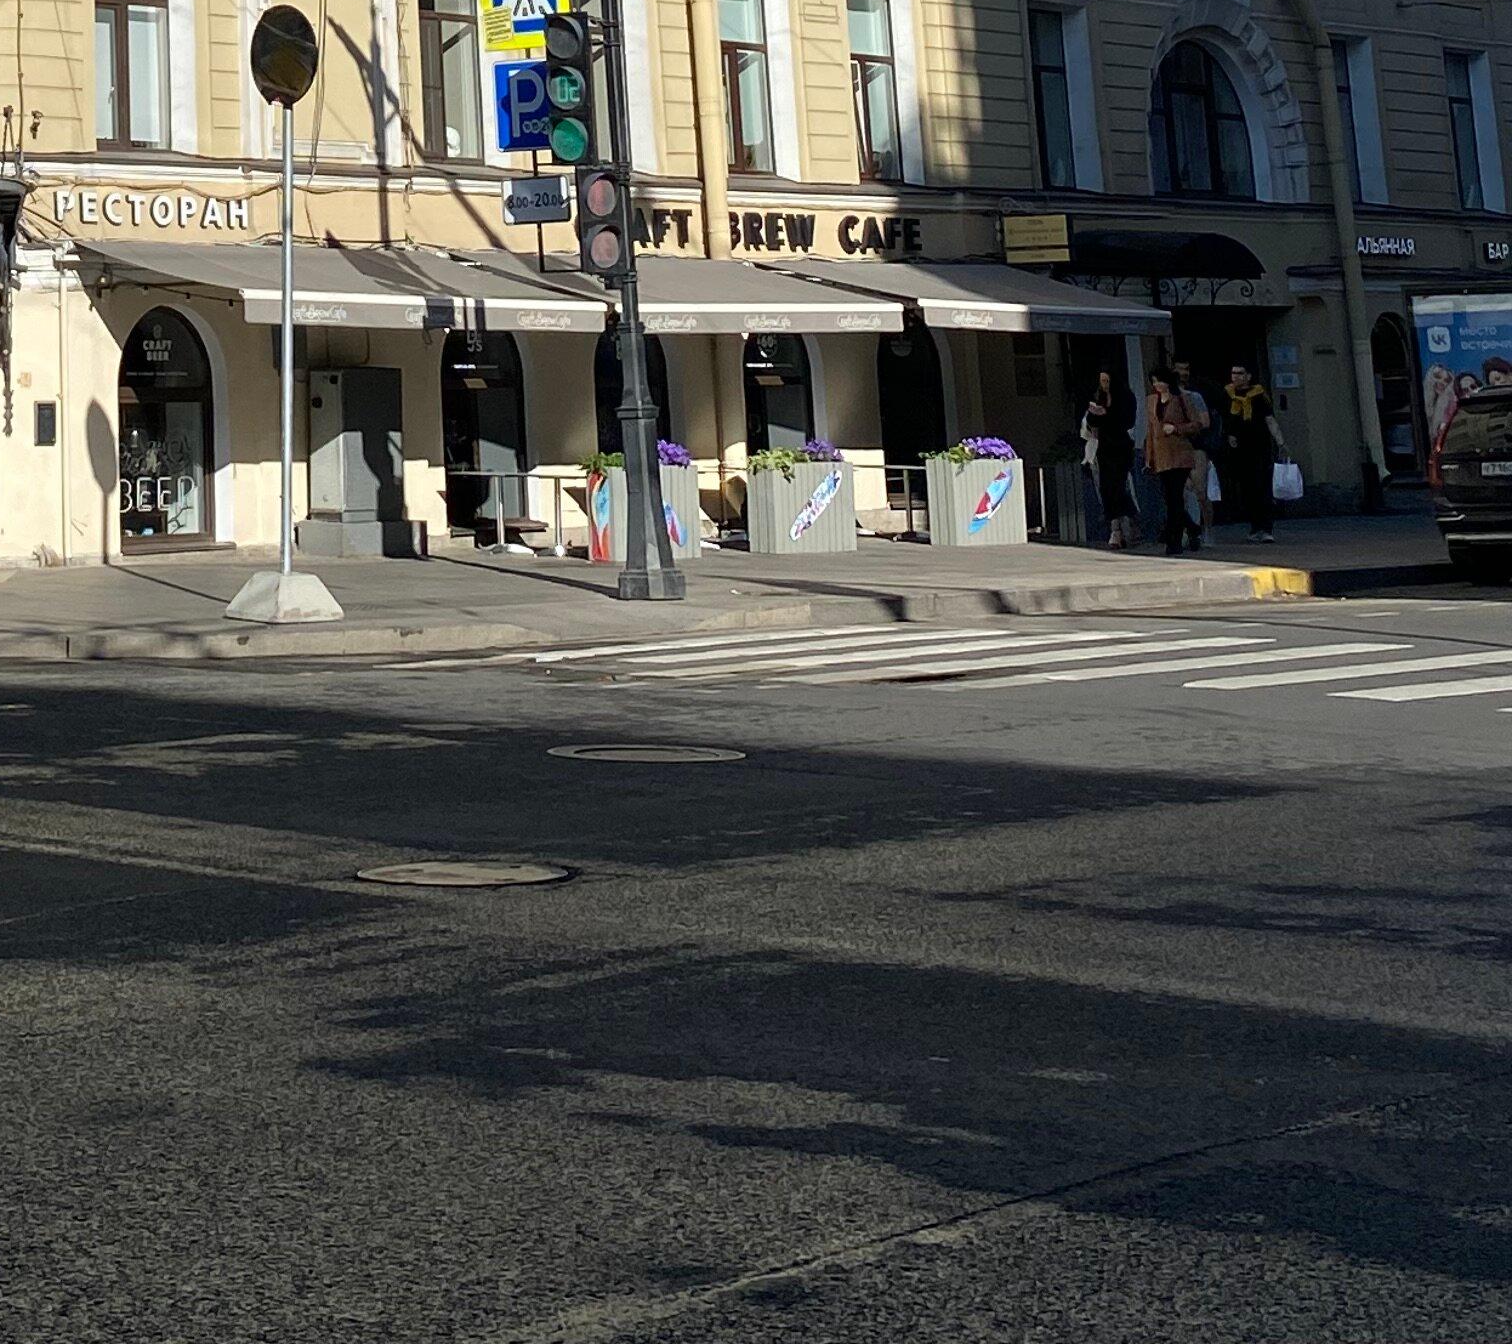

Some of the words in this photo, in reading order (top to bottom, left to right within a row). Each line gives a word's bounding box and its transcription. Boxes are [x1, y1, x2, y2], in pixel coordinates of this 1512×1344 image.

[54, 190, 249, 230] РЕСТОРАН
[837, 214, 924, 254] CAFE
[1357, 236, 1416, 255] АЛЬЯННАЯ
[1487, 242, 1509, 260] БАР
[142, 339, 173, 351] CRAFT
[146, 350, 170, 361] BEER
